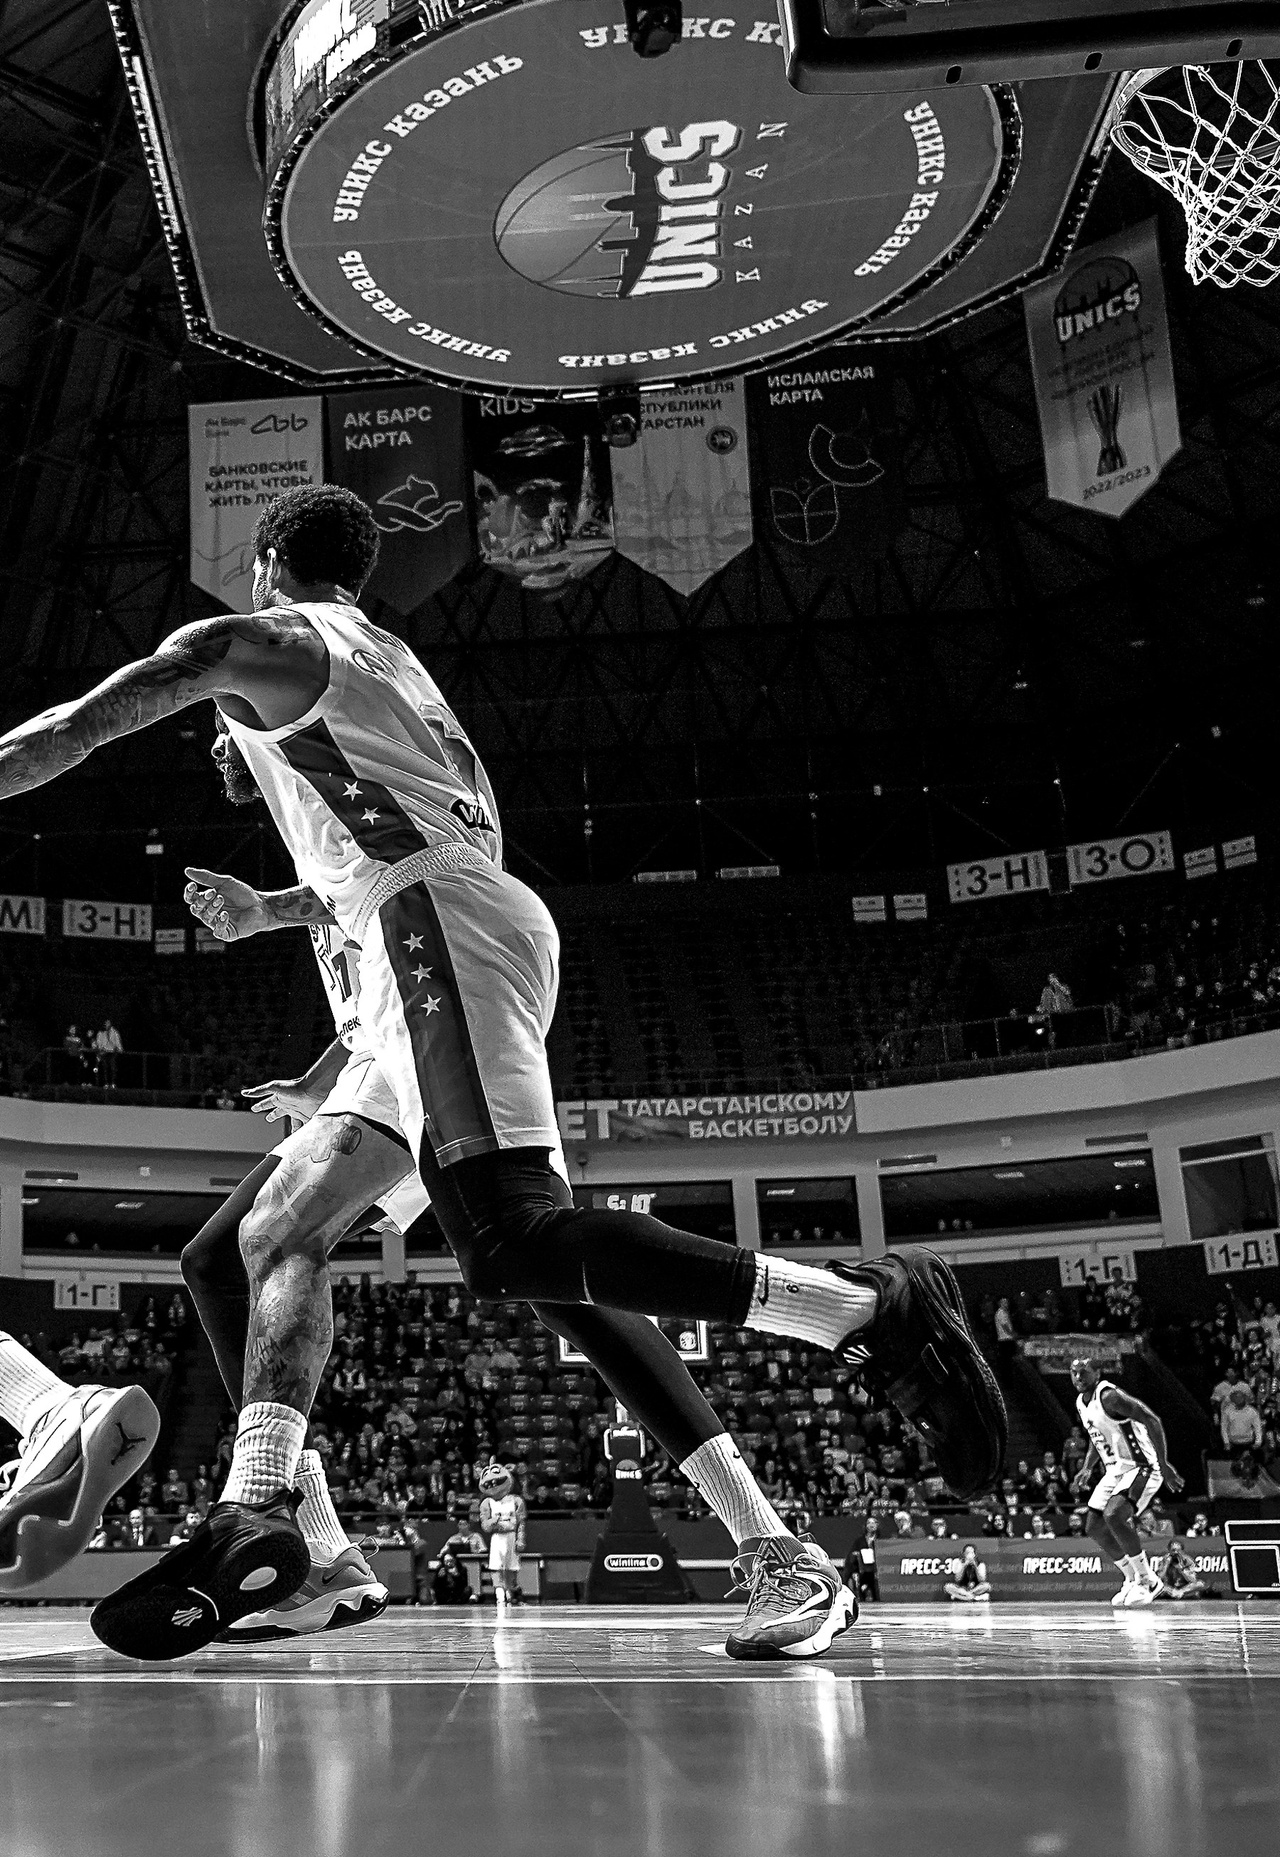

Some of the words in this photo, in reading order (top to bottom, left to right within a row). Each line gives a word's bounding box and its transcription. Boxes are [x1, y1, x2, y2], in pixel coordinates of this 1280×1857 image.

[627, 119, 738, 297] UNICS
[1056, 282, 1141, 342] UNICS
[767, 365, 876, 389] ИСЛАМСКАЯ
[480, 398, 536, 417] KIDS
[770, 387, 823, 407] КАРТА
[343, 409, 372, 429] АК
[375, 404, 434, 426] БАРС
[641, 415, 705, 430] АРСТАН
[344, 430, 414, 451] КАРТА
[208, 460, 308, 478] БАНКОВСКИЕ
[621, 1090, 852, 1118] ТАТАРСТАНСКОМУ
[689, 1114, 854, 1139] БАСКЕТБОЛУ
[900, 1557, 961, 1575] ПРЕСС-ЗО
[1022, 1556, 1102, 1575] ПРЕСС-ЗОНА
